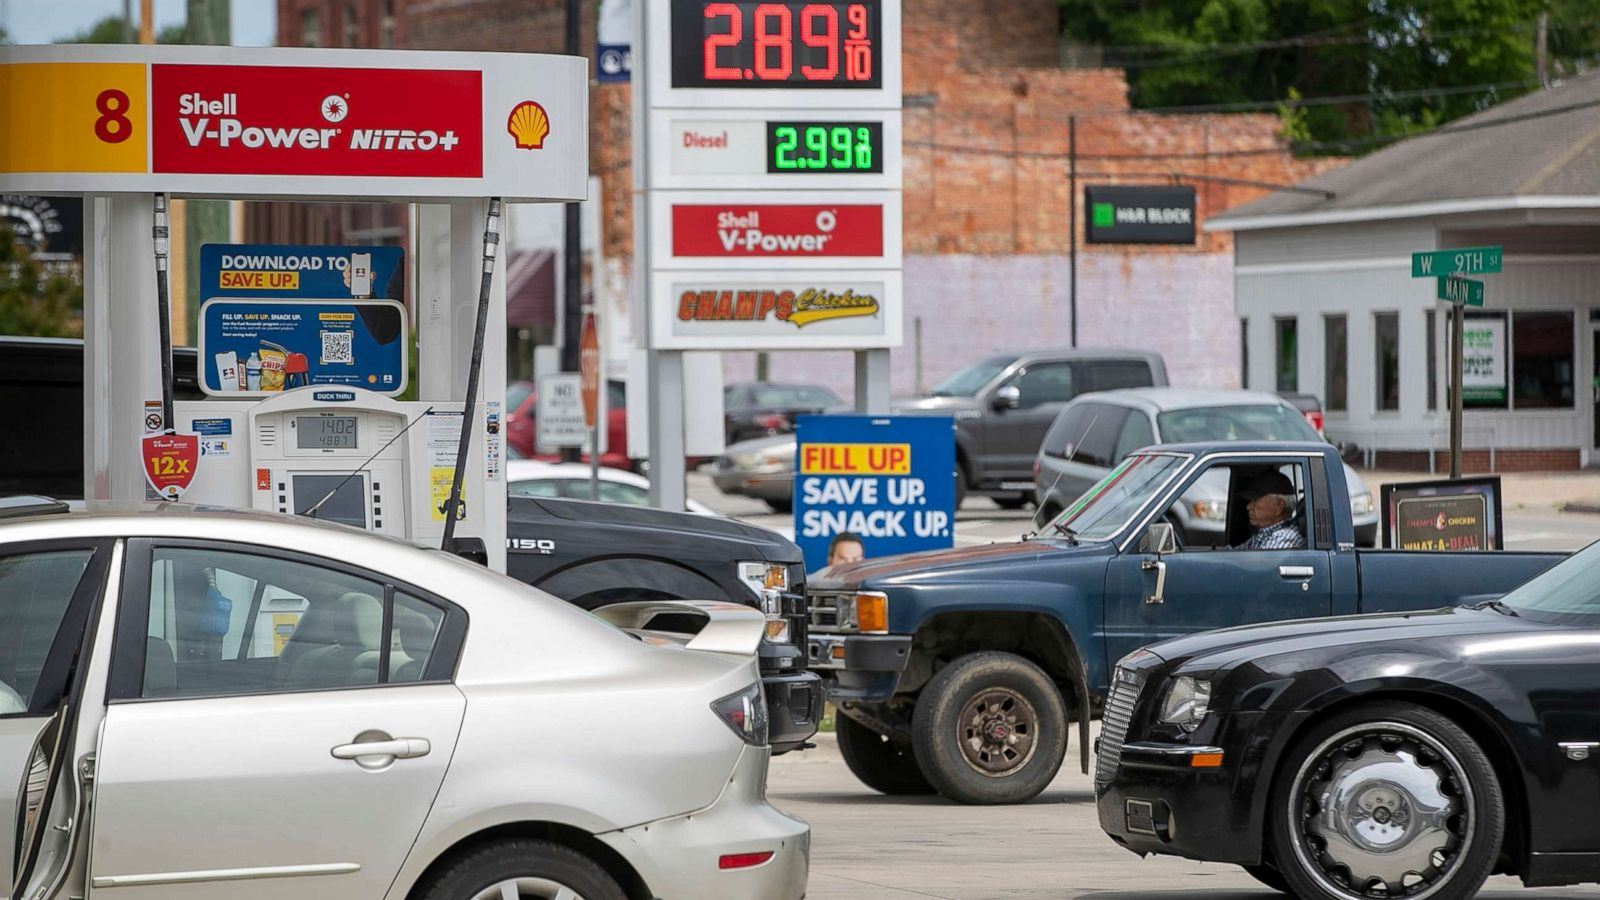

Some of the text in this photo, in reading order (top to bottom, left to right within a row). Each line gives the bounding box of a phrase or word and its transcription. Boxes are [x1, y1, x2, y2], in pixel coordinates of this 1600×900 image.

[704, 3, 839, 80] 2.89
[179, 93, 237, 116] Shell
[94, 89, 132, 144] 8
[179, 118, 333, 150] V-Power
[683, 131, 728, 148] Diesel
[775, 127, 853, 169] 2.99
[717, 211, 759, 229] Shell
[717, 230, 827, 251] V-Power
[221, 255, 350, 270] DOWNLOAD TO
[1420, 255, 1432, 274] W
[1454, 251, 1483, 273] 9TH
[222, 272, 297, 288] SAVE UP.
[678, 290, 796, 321] CHAMPS
[261, 360, 286, 371] CHIPS
[151, 456, 191, 476] 12x
[804, 447, 907, 471] FILL UP.
[803, 477, 927, 506] SAVE UP.
[803, 510, 949, 538] SNACK UP.
